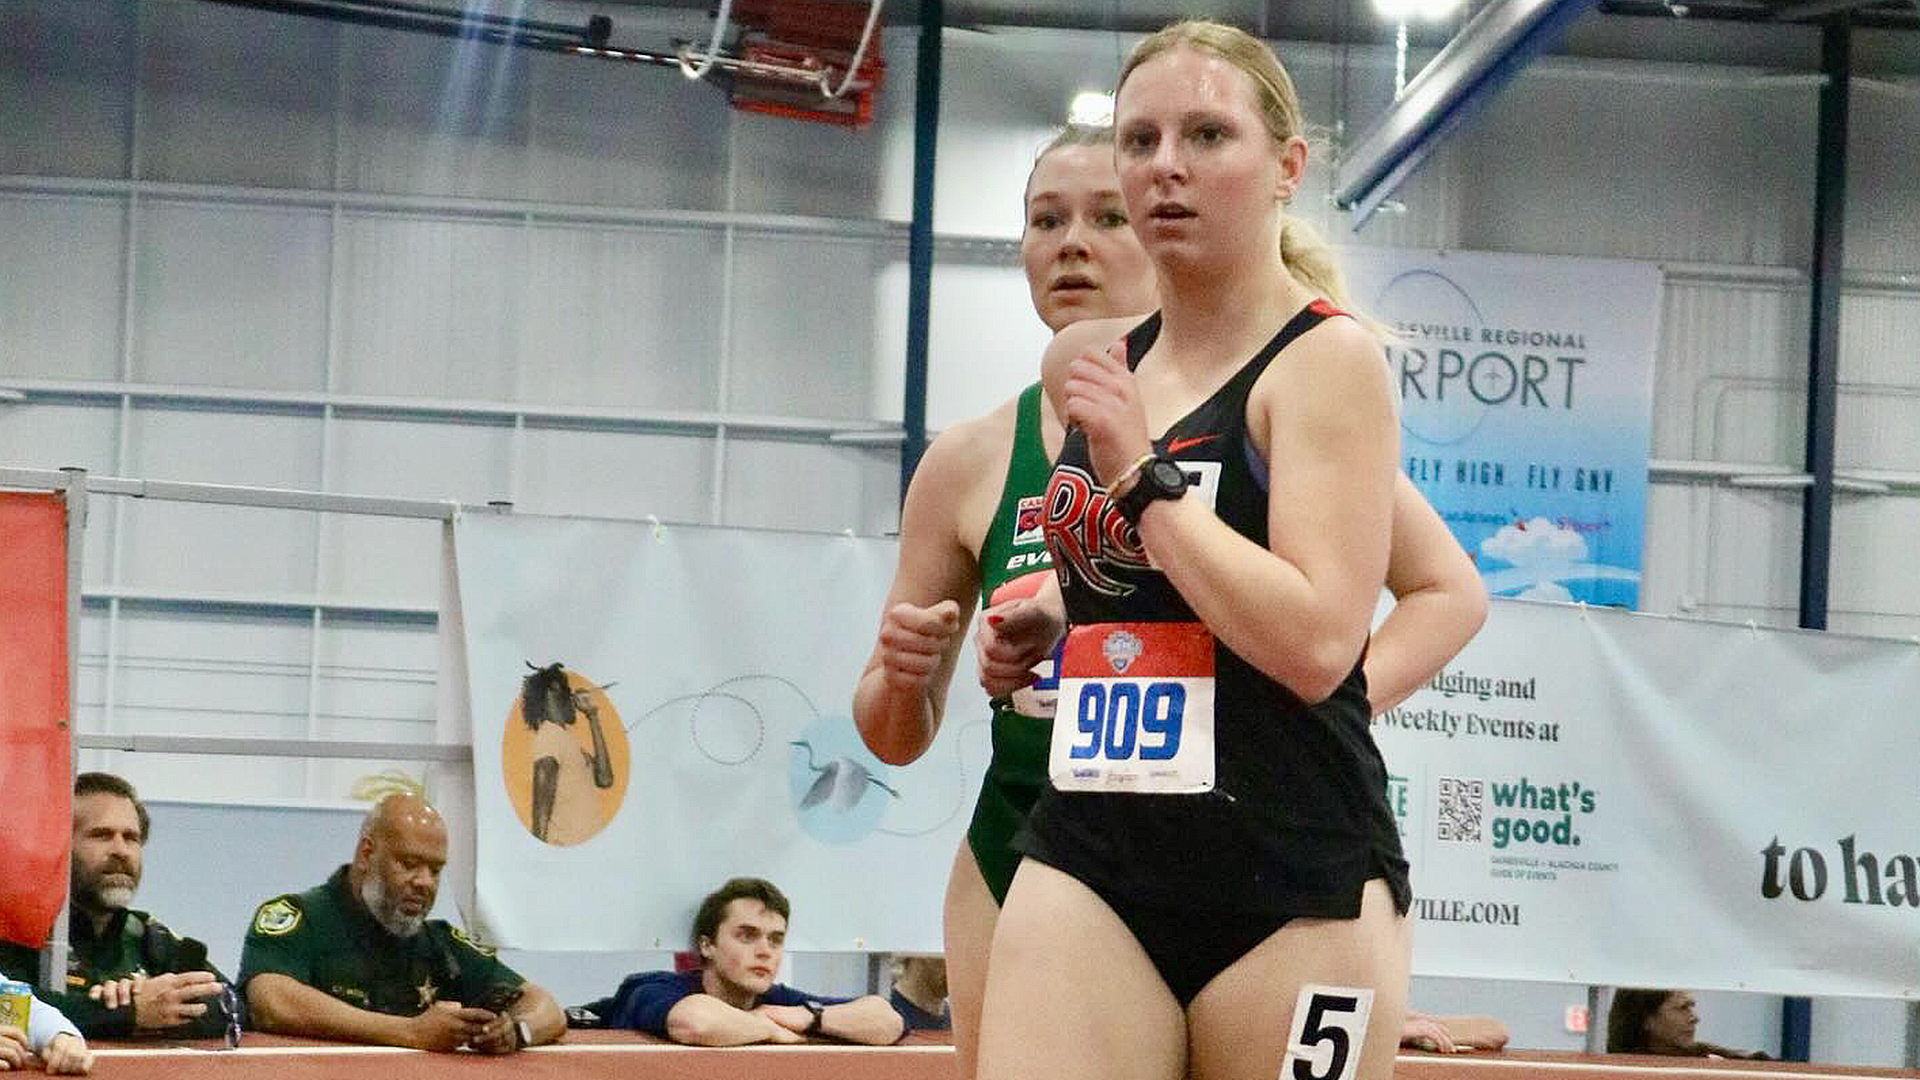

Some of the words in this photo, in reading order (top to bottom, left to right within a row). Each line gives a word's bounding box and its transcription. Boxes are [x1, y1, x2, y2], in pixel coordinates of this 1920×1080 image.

[1481, 328, 1586, 349] REGIONAL
[1408, 457, 1442, 482] FLY
[1528, 464, 1561, 489] FLY
[1418, 669, 1491, 701] dging
[1496, 677, 1536, 701] and
[1069, 682, 1188, 760] 909
[1383, 706, 1461, 739] Weekly
[1466, 713, 1536, 740] Events
[1539, 721, 1560, 743] at
[1491, 777, 1596, 814] what's
[1491, 814, 1581, 849] good.
[1761, 834, 1828, 901] to
[1838, 832, 1920, 908] ha
[1293, 993, 1358, 1080] 5
